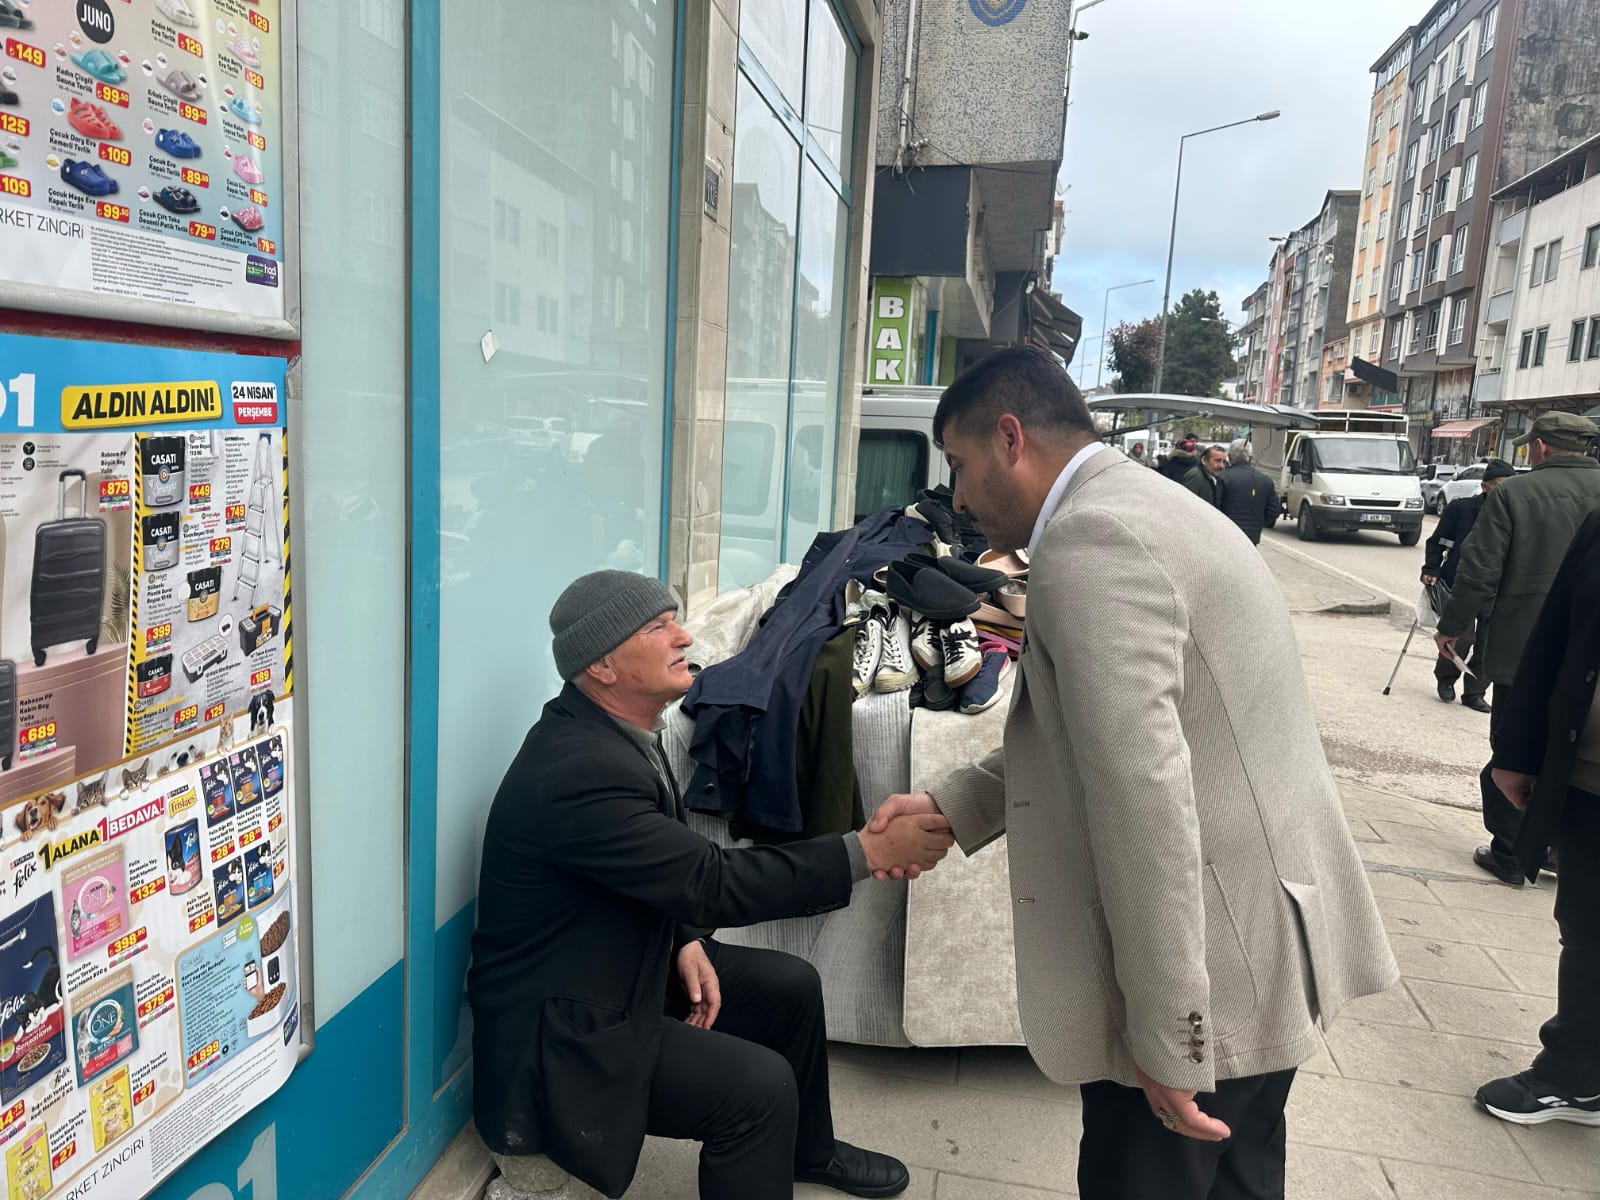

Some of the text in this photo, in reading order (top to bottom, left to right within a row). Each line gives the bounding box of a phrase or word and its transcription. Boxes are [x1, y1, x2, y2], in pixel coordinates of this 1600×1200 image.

[81, 4, 111, 32] JUNO
[72, 387, 215, 420] ALDIN ALDIN!
[232, 386, 246, 400] 24
[238, 407, 273, 420] PERŞEMBE
[150, 454, 176, 466] CASATI
[150, 526, 173, 537] CASATI
[52, 829, 100, 863] ALANA
[110, 796, 165, 836] BEDAVA!
[16, 1025, 53, 1054] Sensations
